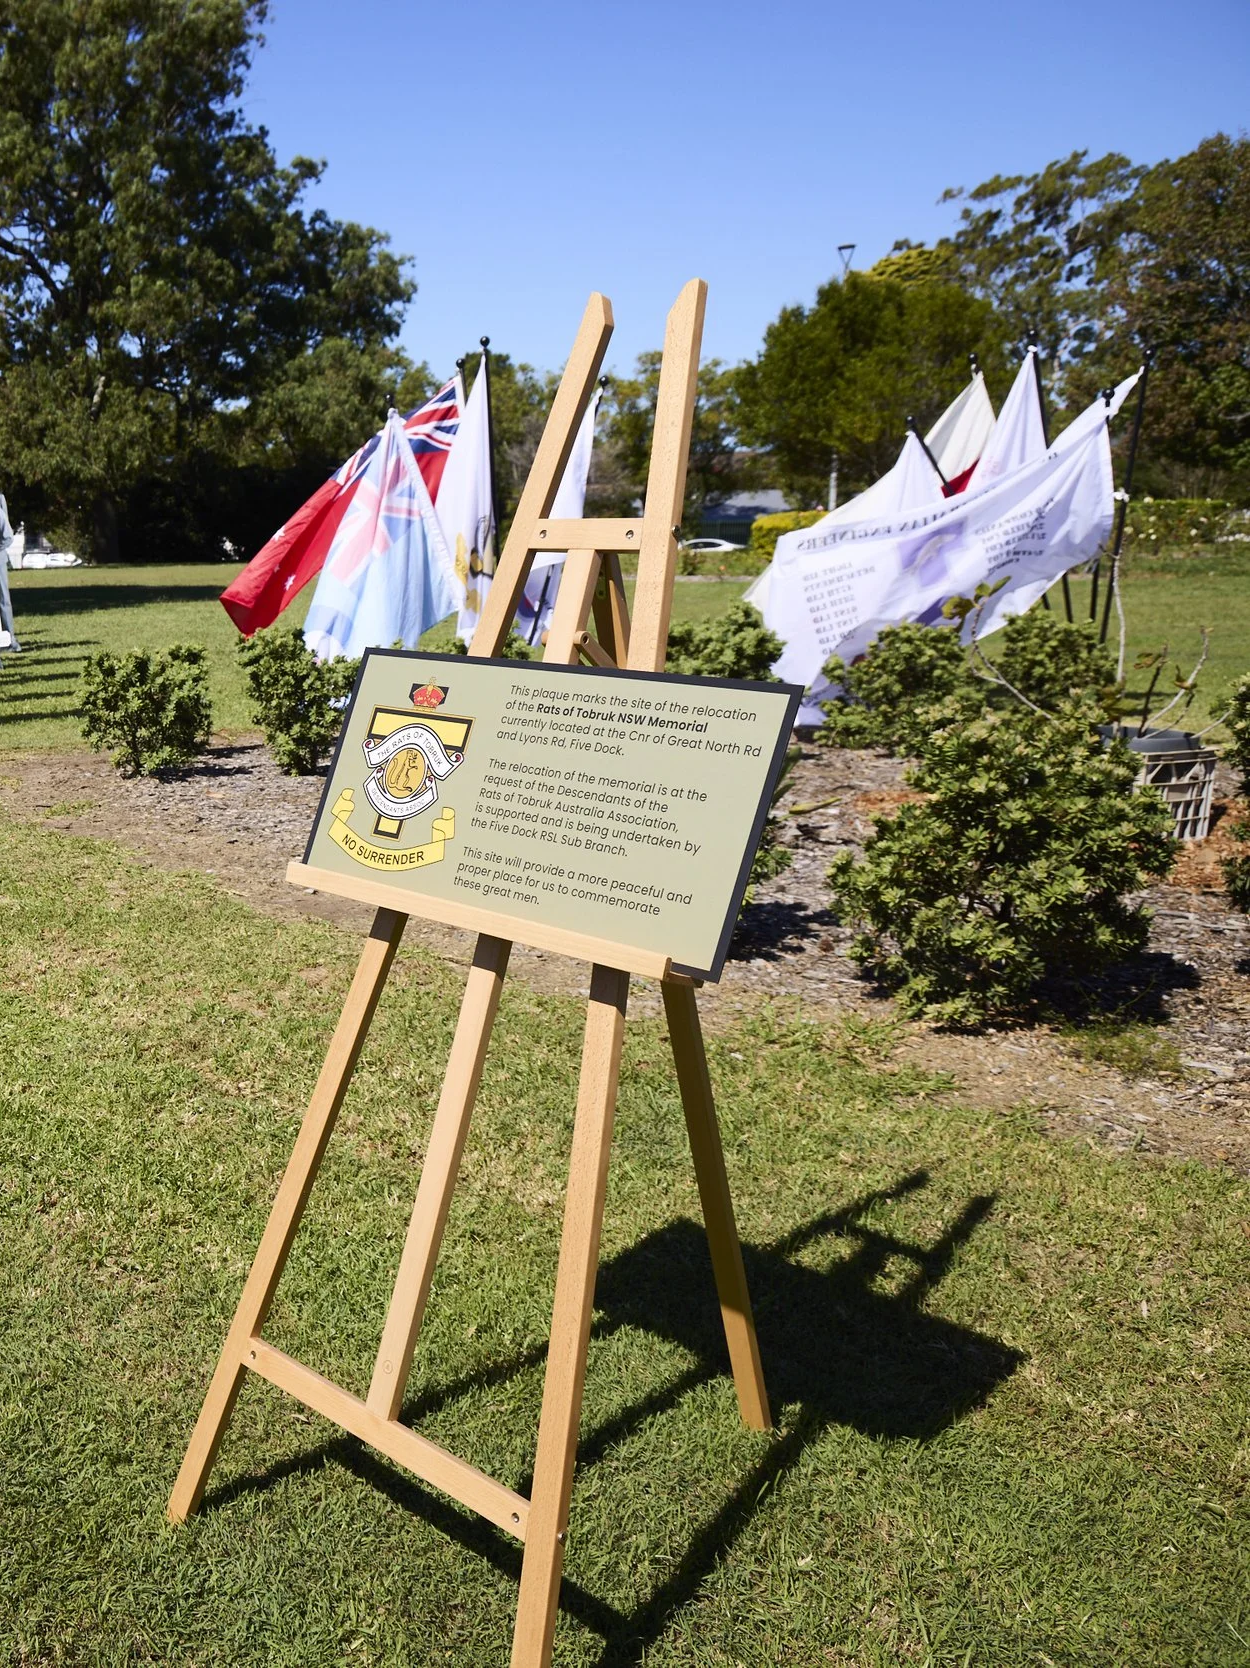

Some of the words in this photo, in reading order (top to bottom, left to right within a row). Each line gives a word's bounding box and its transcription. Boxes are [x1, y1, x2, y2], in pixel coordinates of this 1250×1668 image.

[505, 699, 517, 710] of
[517, 701, 534, 712] the
[536, 703, 561, 715] Rats
[562, 706, 575, 717] of
[576, 707, 616, 722] Tobruk
[617, 712, 647, 725] NSW
[647, 716, 709, 733] Memorial
[511, 685, 530, 696] This
[531, 688, 570, 702] plaque
[571, 693, 607, 705] marks
[609, 695, 628, 707] the
[630, 697, 652, 710] site
[654, 700, 668, 711] of
[669, 702, 689, 714] the
[691, 705, 757, 722] relocation
[377, 746, 390, 759] THE
[392, 733, 411, 748] RATS
[413, 731, 424, 739] OF
[423, 738, 444, 768] TOBRUK
[496, 730, 518, 741] and
[519, 732, 549, 745] Lyons
[550, 736, 567, 749] Rd,
[569, 738, 592, 751] Five
[594, 742, 624, 756] Dock.
[501, 716, 547, 732] currently
[548, 720, 591, 735] located
[592, 727, 605, 737] at
[607, 727, 626, 740] the
[629, 730, 651, 742] Cnr
[652, 733, 666, 744] of
[667, 735, 703, 750] Great
[705, 740, 740, 755] North
[743, 744, 762, 757] Rd
[483, 775, 523, 789] request
[524, 780, 537, 790] of
[537, 782, 555, 794] the
[557, 785, 631, 807] Descendants
[633, 798, 647, 809] of
[648, 800, 668, 813] the
[489, 758, 507, 770] The
[508, 763, 561, 779] relocation
[564, 770, 576, 781] of
[577, 772, 596, 784] the
[597, 777, 656, 794] memorial
[657, 783, 668, 796] is
[670, 788, 684, 799] at
[687, 789, 707, 802] the
[371, 788, 404, 814] DESCENDANTS
[479, 787, 502, 800] Rats
[503, 792, 515, 802] of
[517, 794, 553, 809] Tobruk
[554, 801, 605, 819] Australia
[606, 810, 678, 834] Association,
[471, 817, 487, 829] the
[489, 820, 509, 833] Five
[511, 825, 538, 839] Dock
[539, 830, 557, 843] RSL
[560, 834, 582, 848] Sub
[584, 839, 627, 857] Branch.
[475, 801, 484, 813] is
[485, 806, 539, 823] supported
[541, 816, 564, 827] and
[564, 818, 574, 830] is
[576, 820, 609, 840] being
[612, 829, 681, 850] undertaken
[684, 840, 701, 856] by
[342, 834, 357, 850] NO
[357, 846, 424, 865] SURRENDER
[453, 876, 481, 891] these
[482, 884, 511, 898] great
[513, 891, 539, 905] men.
[456, 863, 492, 877] proper
[492, 870, 523, 884] place
[524, 875, 540, 888] for
[542, 882, 555, 892] us
[557, 883, 569, 895] to
[571, 888, 660, 916] commemorate
[463, 846, 482, 859] This
[484, 851, 502, 864] site
[505, 856, 522, 868] will
[522, 861, 565, 877] provide
[567, 870, 575, 879] a
[577, 873, 608, 887] more
[609, 880, 665, 899] peaceful
[666, 892, 693, 905] and
